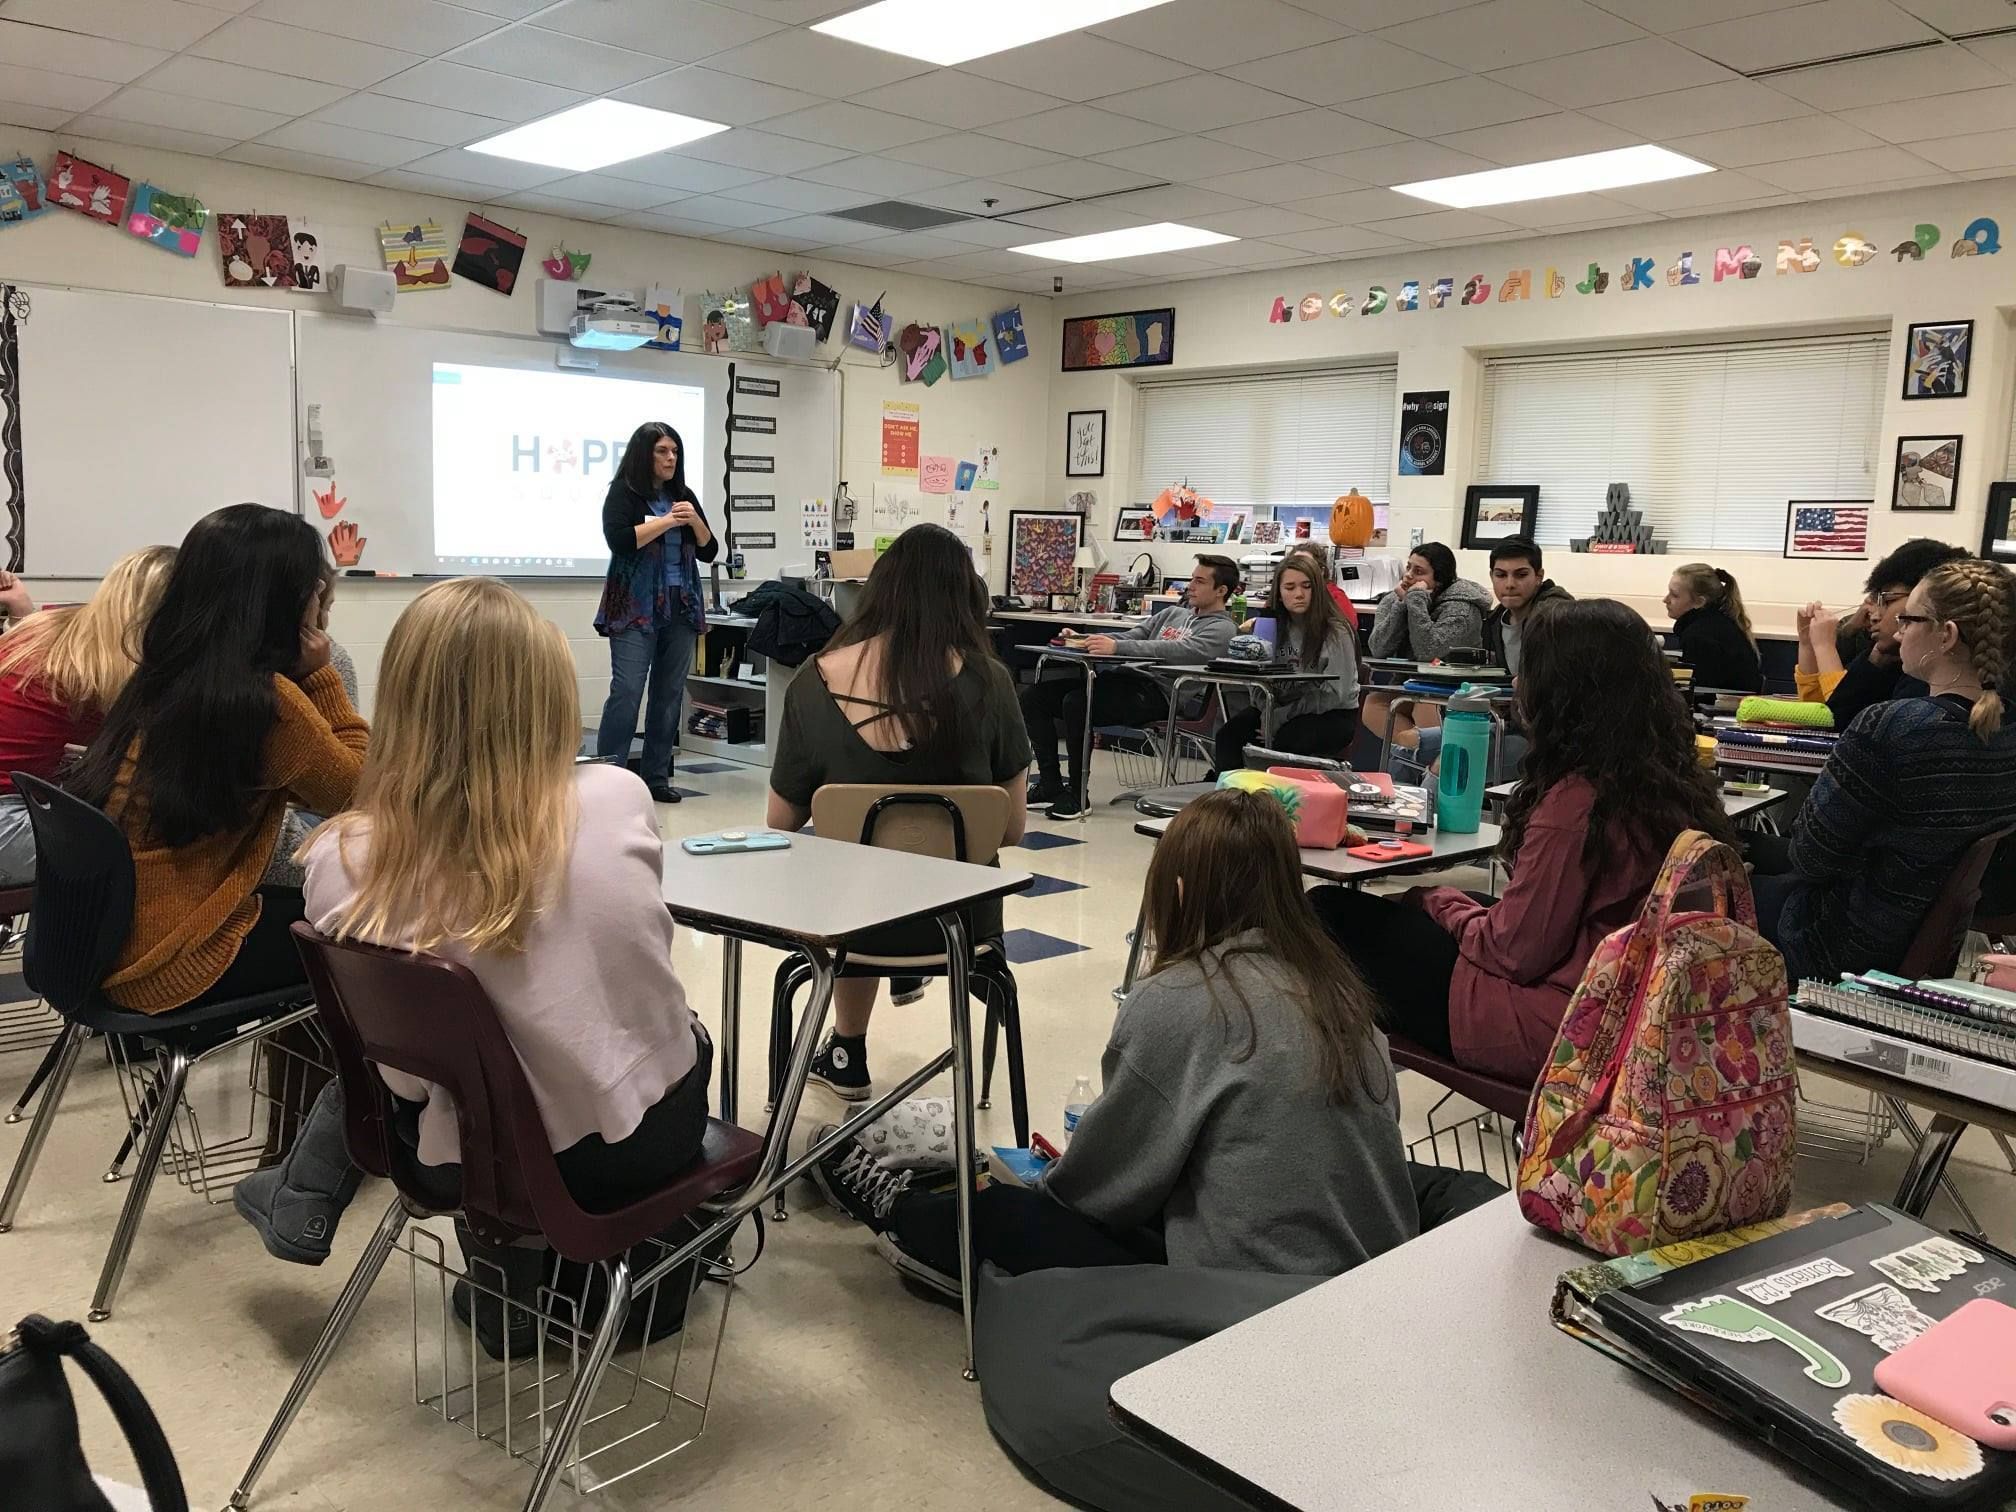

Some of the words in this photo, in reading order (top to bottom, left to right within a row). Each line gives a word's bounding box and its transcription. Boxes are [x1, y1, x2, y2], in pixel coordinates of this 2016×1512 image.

[1632, 257, 1655, 290] K
[1681, 252, 1700, 285] L
[1713, 245, 1753, 282] M
[1964, 217, 2002, 255] Q
[1402, 402, 1419, 412] #why
[1433, 401, 1448, 411] sign
[1773, 1260, 1846, 1288] Romans
[1972, 1277, 2006, 1296] acer
[1682, 1321, 1742, 1338] HERBIVORE
